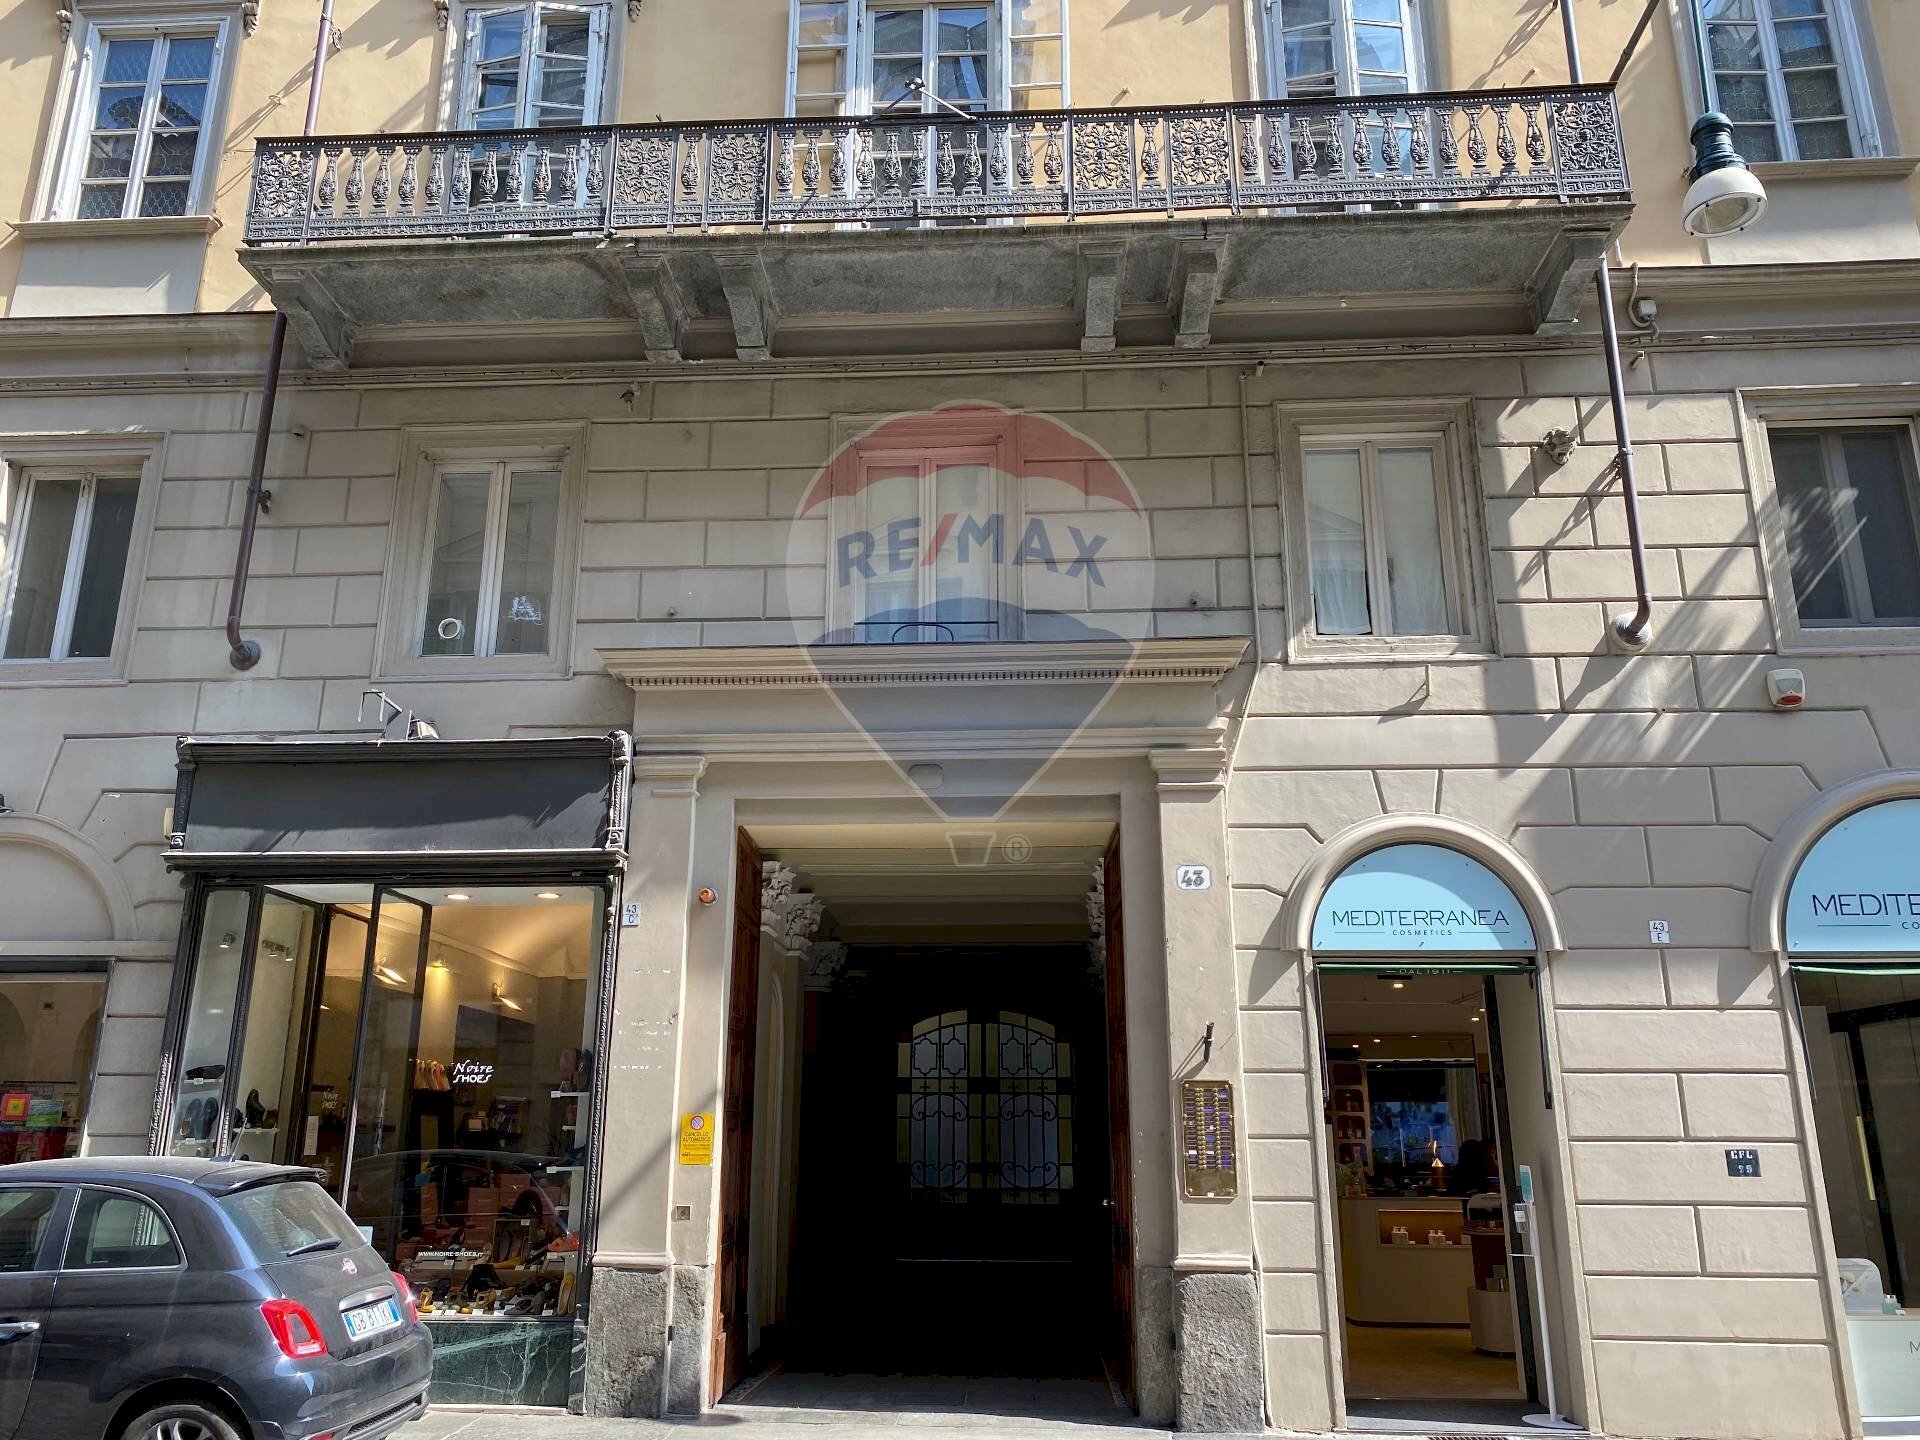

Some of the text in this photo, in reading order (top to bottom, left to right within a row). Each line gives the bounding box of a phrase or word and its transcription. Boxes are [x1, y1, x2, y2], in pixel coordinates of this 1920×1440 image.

[1181, 869, 1205, 887] 43
[626, 904, 637, 914] 43
[1812, 893, 1920, 916] MEDITE
[1332, 909, 1510, 926] MEDITERRANEA
[1653, 921, 1665, 932] 43
[1901, 921, 1920, 930] CO
[1657, 932, 1663, 942] E
[453, 1059, 494, 1075] Noire
[453, 1074, 492, 1083] SHOES
